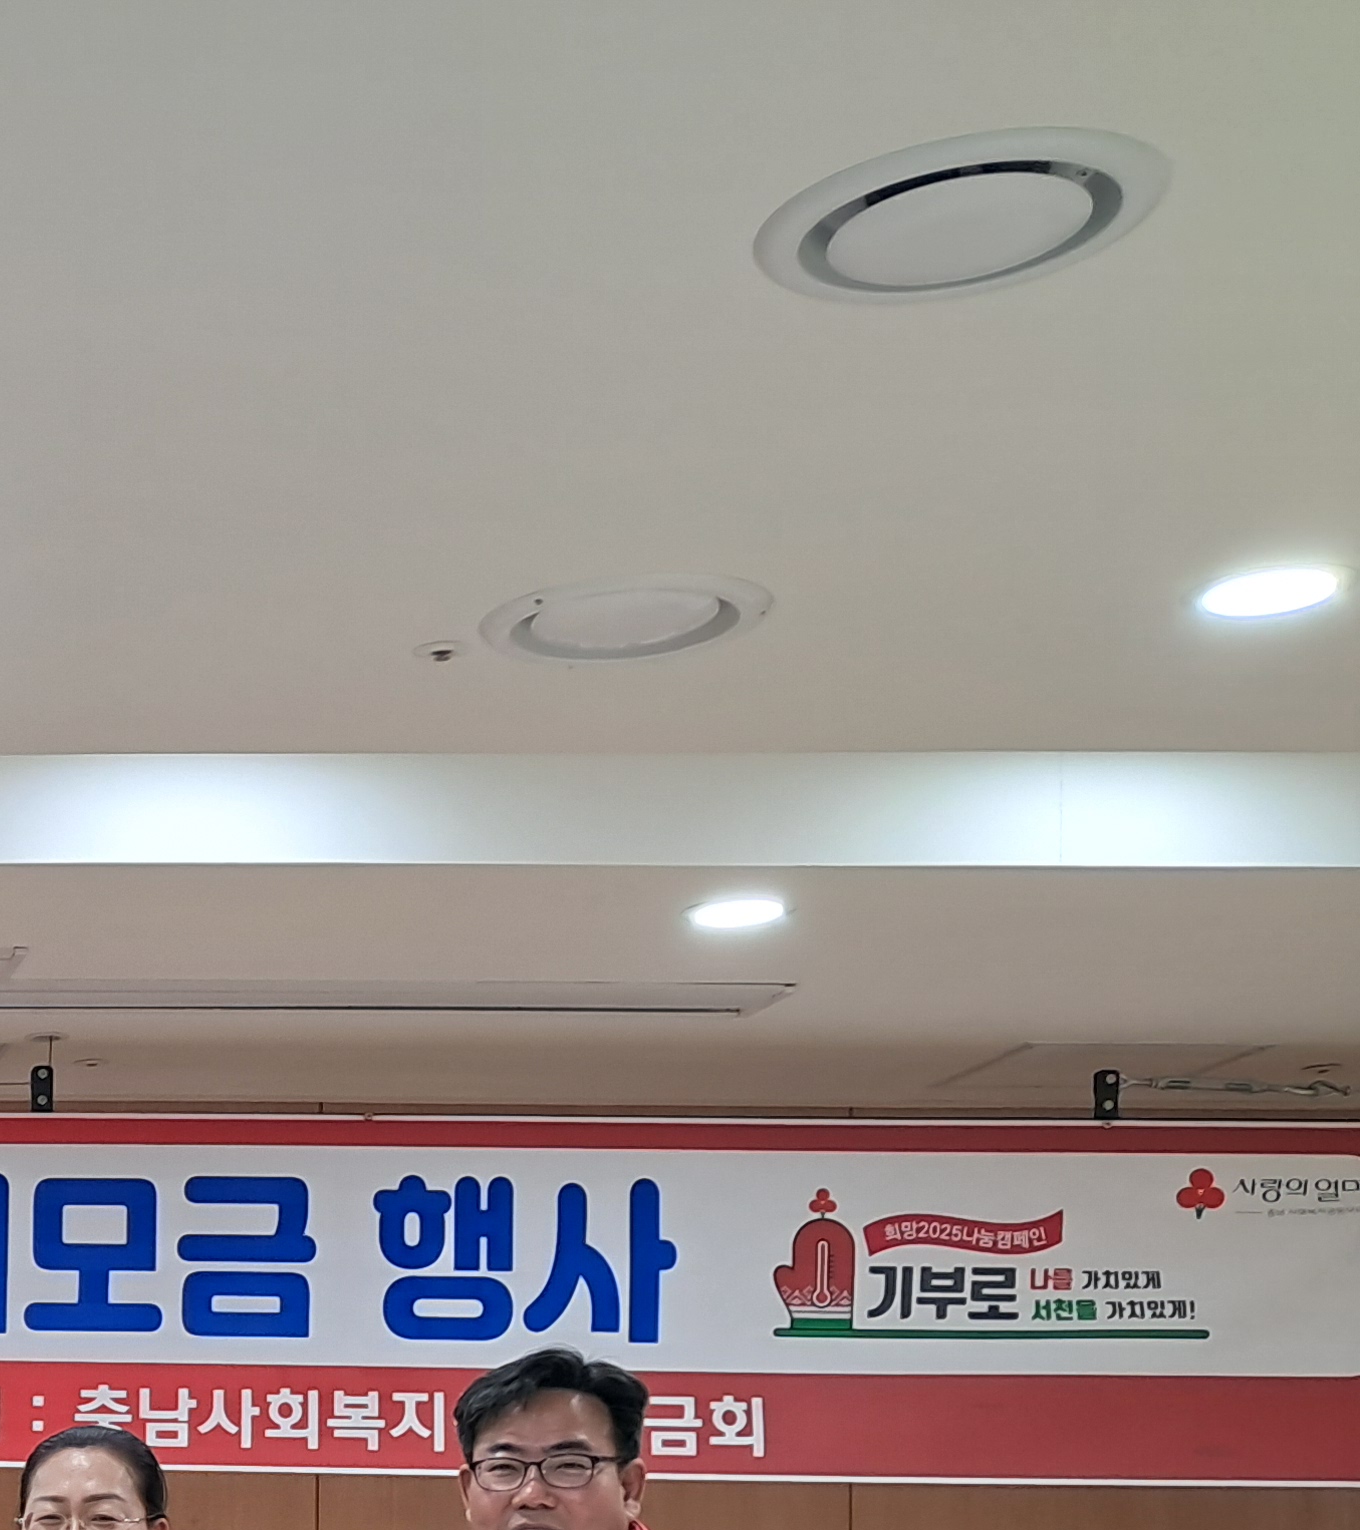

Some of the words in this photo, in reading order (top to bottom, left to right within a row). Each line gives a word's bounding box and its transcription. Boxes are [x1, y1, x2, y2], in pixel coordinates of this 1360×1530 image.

[1233, 1178, 1308, 1203] 사랑의
[884, 1222, 1047, 1249] 희망2025나눔캠페인
[372, 1173, 678, 1344] 행사
[1030, 1268, 1074, 1290] 나를
[1081, 1270, 1162, 1290] 가치있게
[867, 1266, 1019, 1320] 기부로
[1031, 1299, 1098, 1321] 서천을
[1105, 1301, 1197, 1320] 가치있게!
